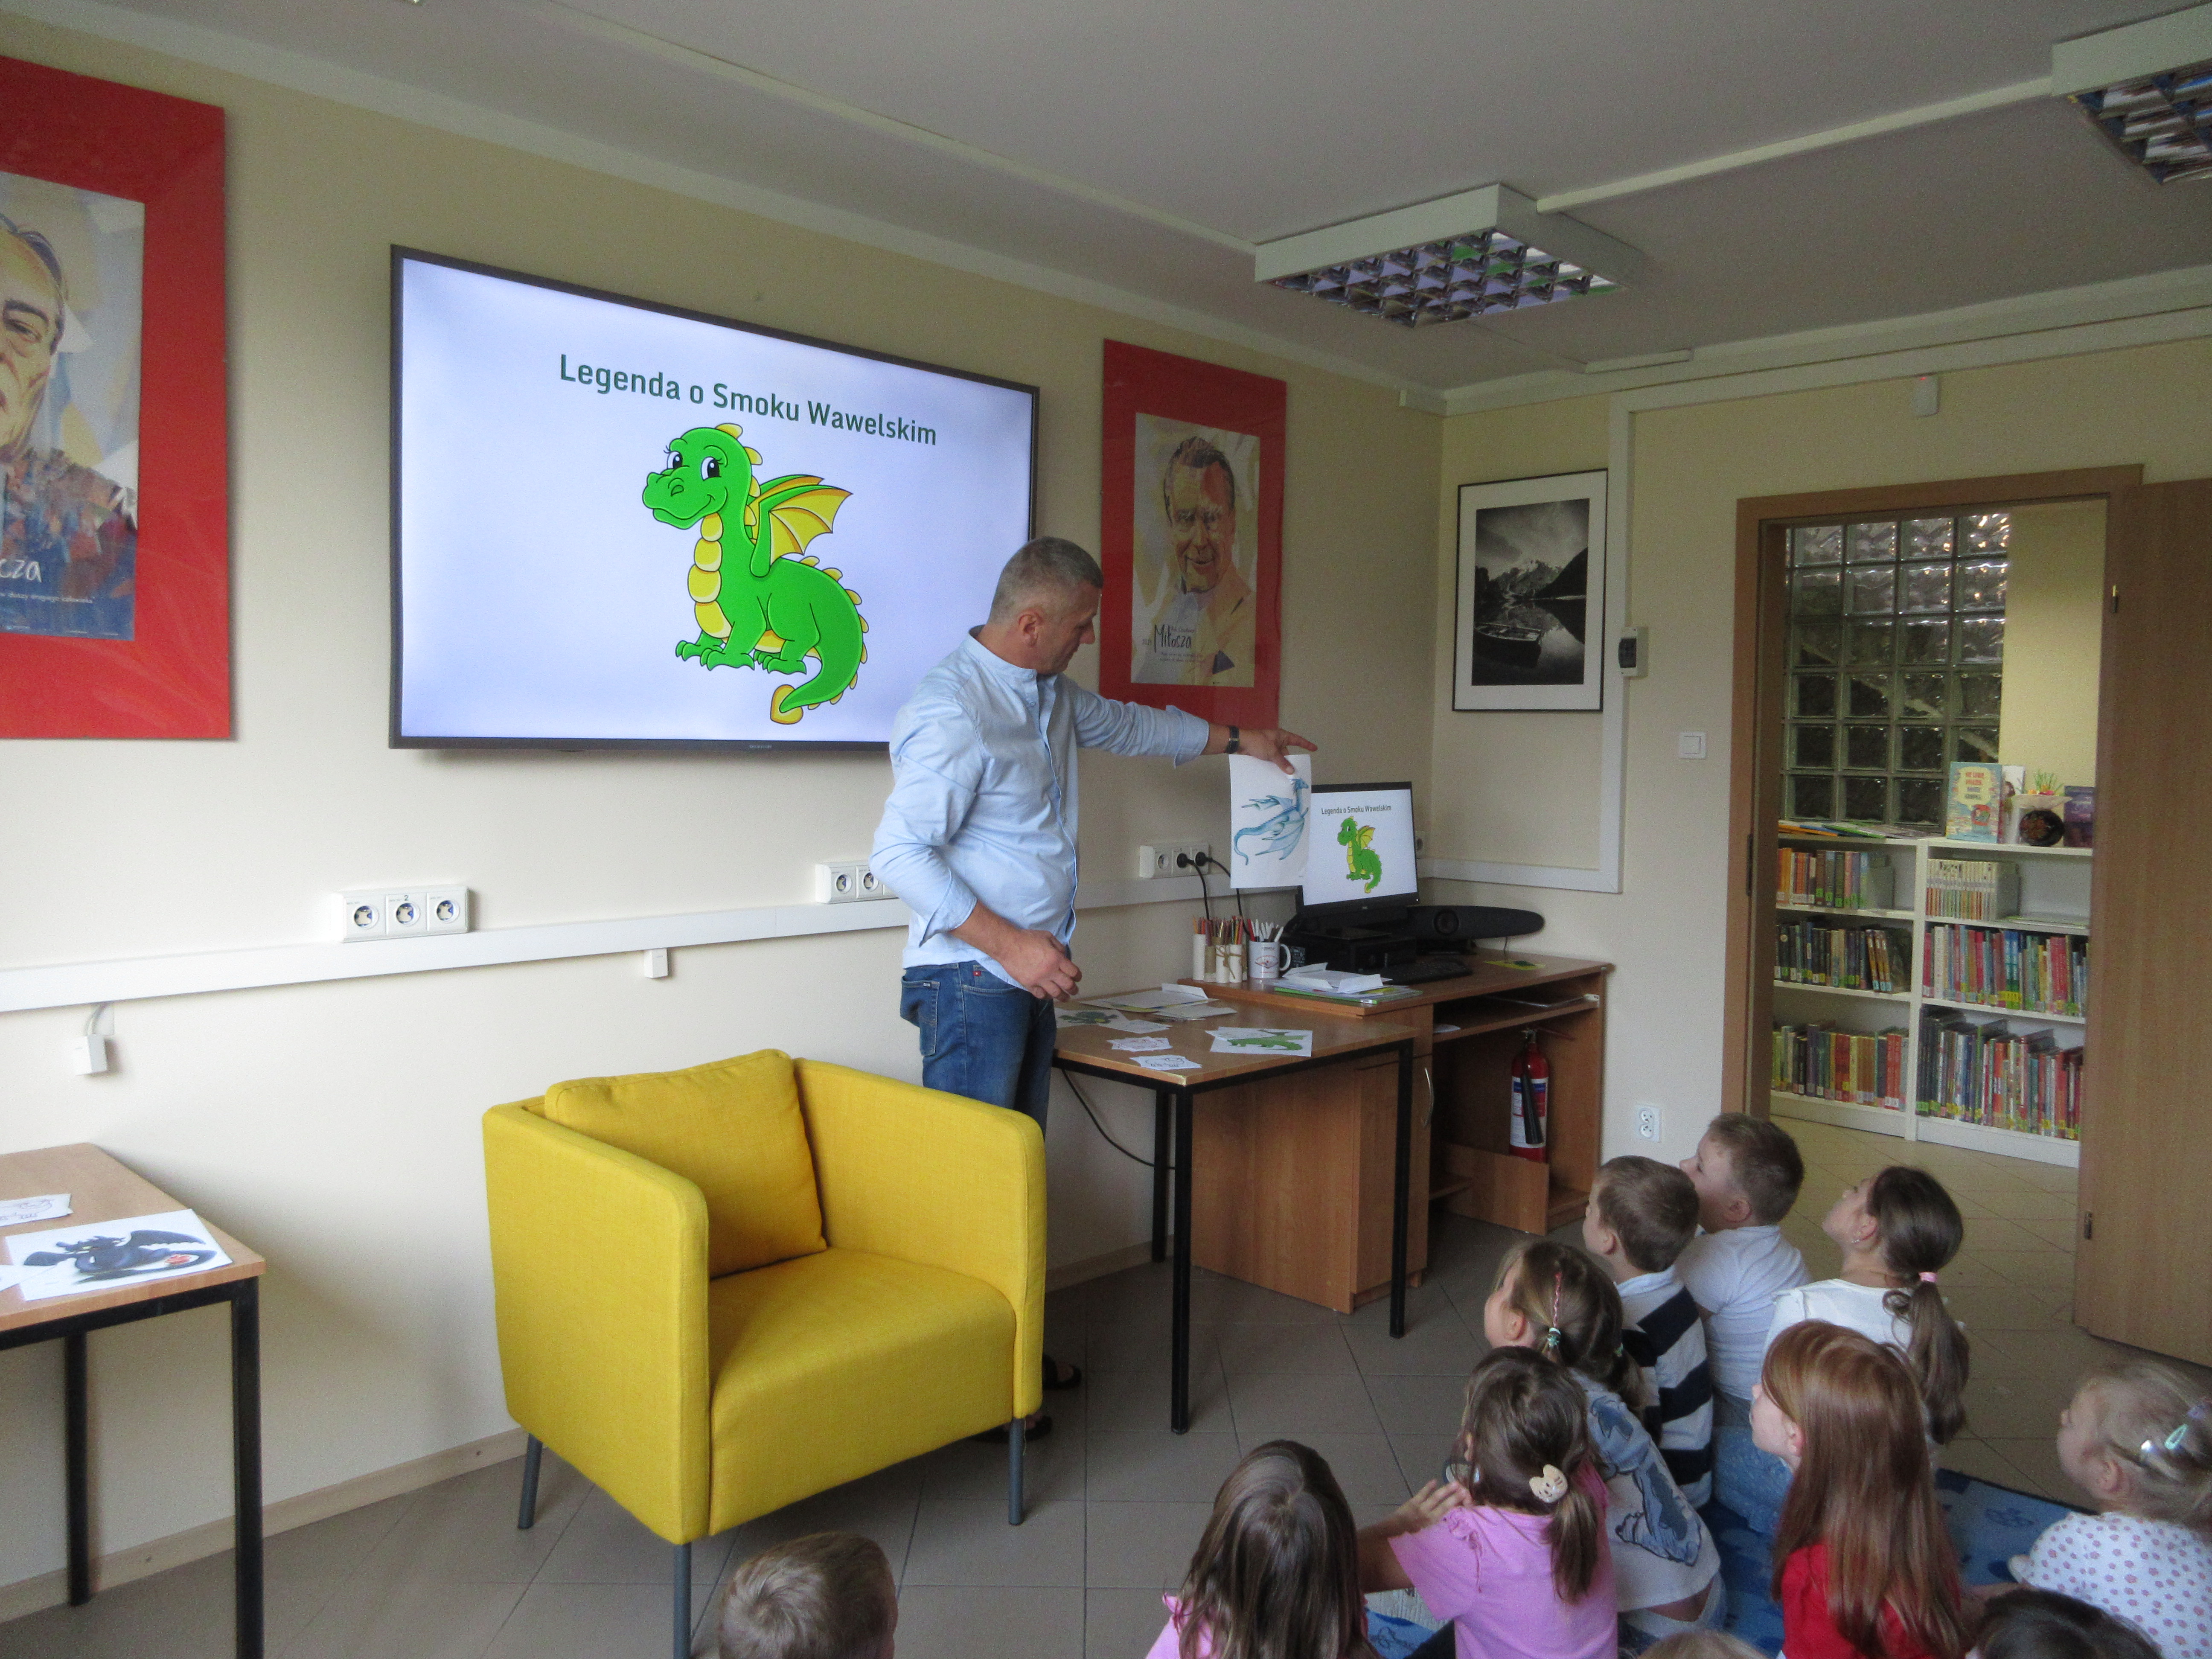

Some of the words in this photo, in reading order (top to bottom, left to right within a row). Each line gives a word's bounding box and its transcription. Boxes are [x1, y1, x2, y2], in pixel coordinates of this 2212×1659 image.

[560, 354, 681, 401] Legenda
[690, 385, 704, 405] o
[713, 382, 800, 422] Smoku
[807, 400, 937, 446] Wawelskim
[1154, 624, 1192, 653] Miłosza
[1321, 807, 1342, 815] Legenda
